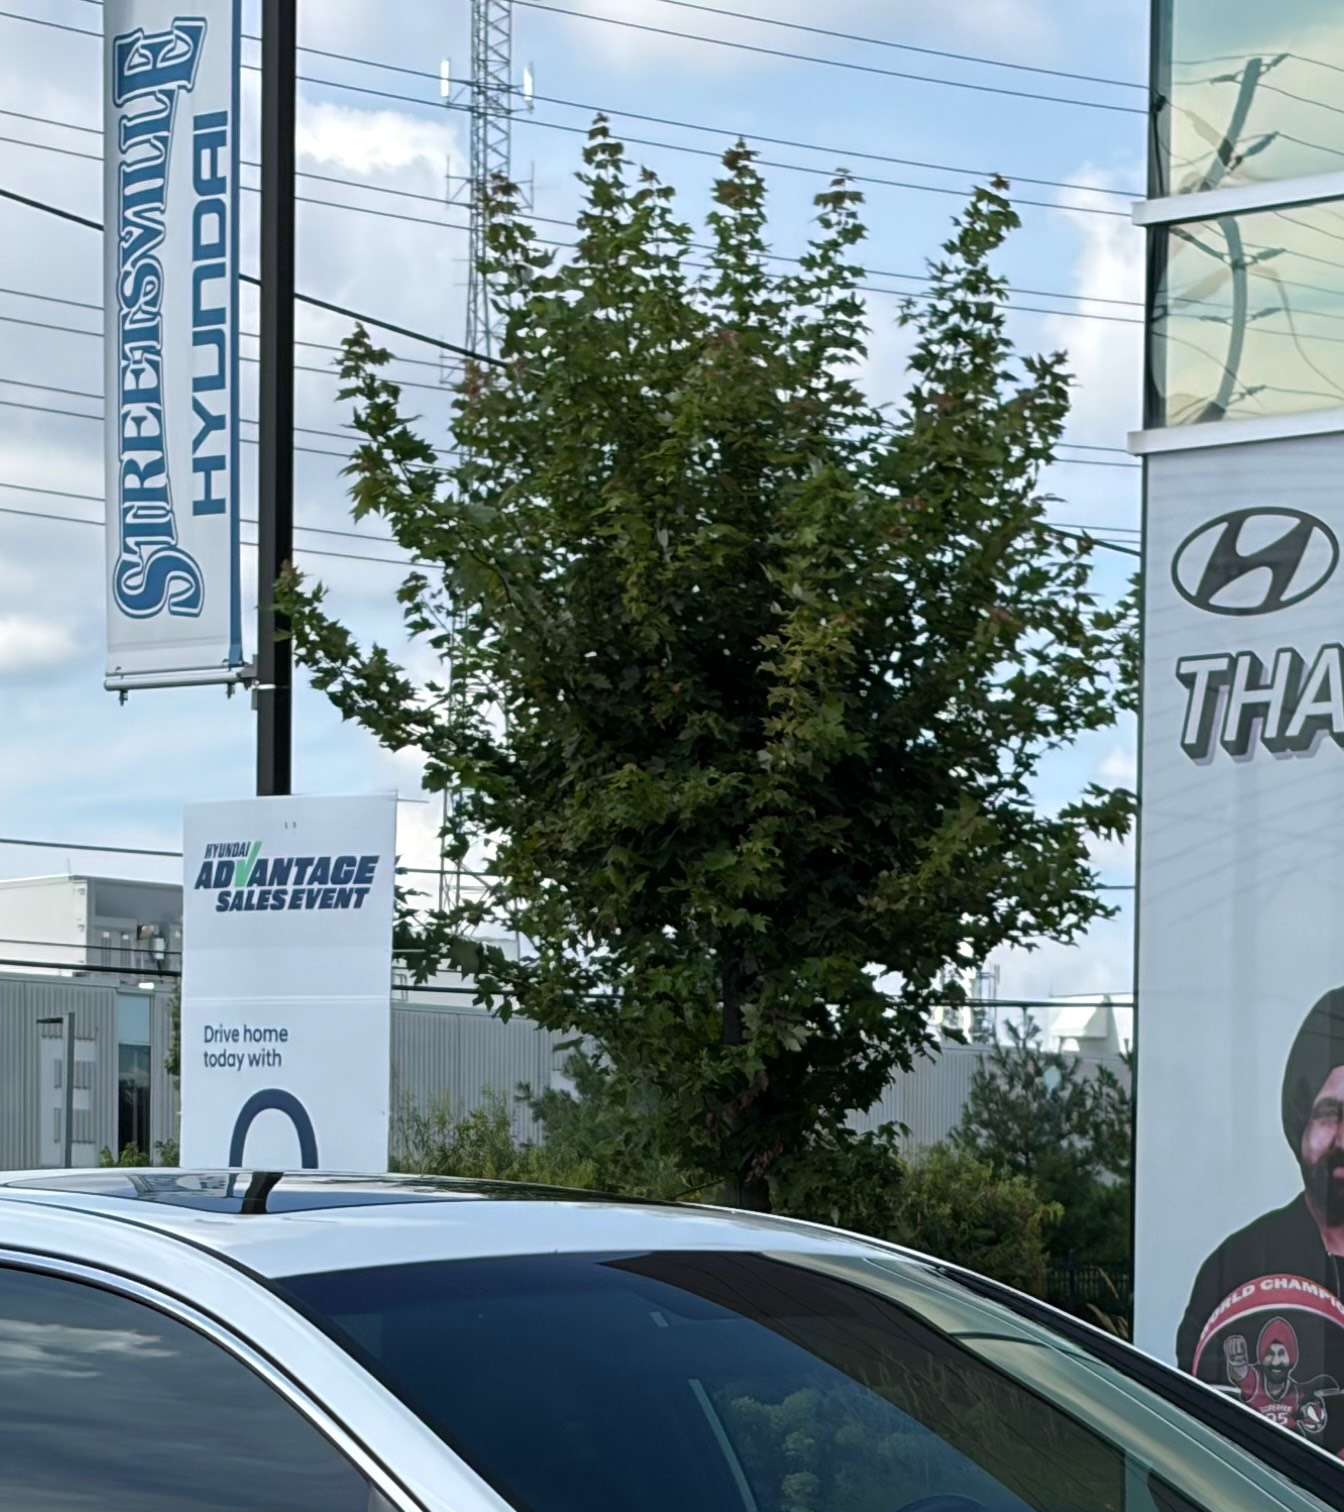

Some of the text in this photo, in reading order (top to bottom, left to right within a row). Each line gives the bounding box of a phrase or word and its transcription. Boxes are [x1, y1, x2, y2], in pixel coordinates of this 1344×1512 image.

[113, 16, 207, 619] STREETSVILLE
[192, 110, 229, 516] HYUNDAI
[205, 841, 252, 858] HYUNDAI
[216, 887, 370, 912] SALES EVENT
[203, 1025, 288, 1043] Drive home
[203, 1049, 282, 1070] today with
